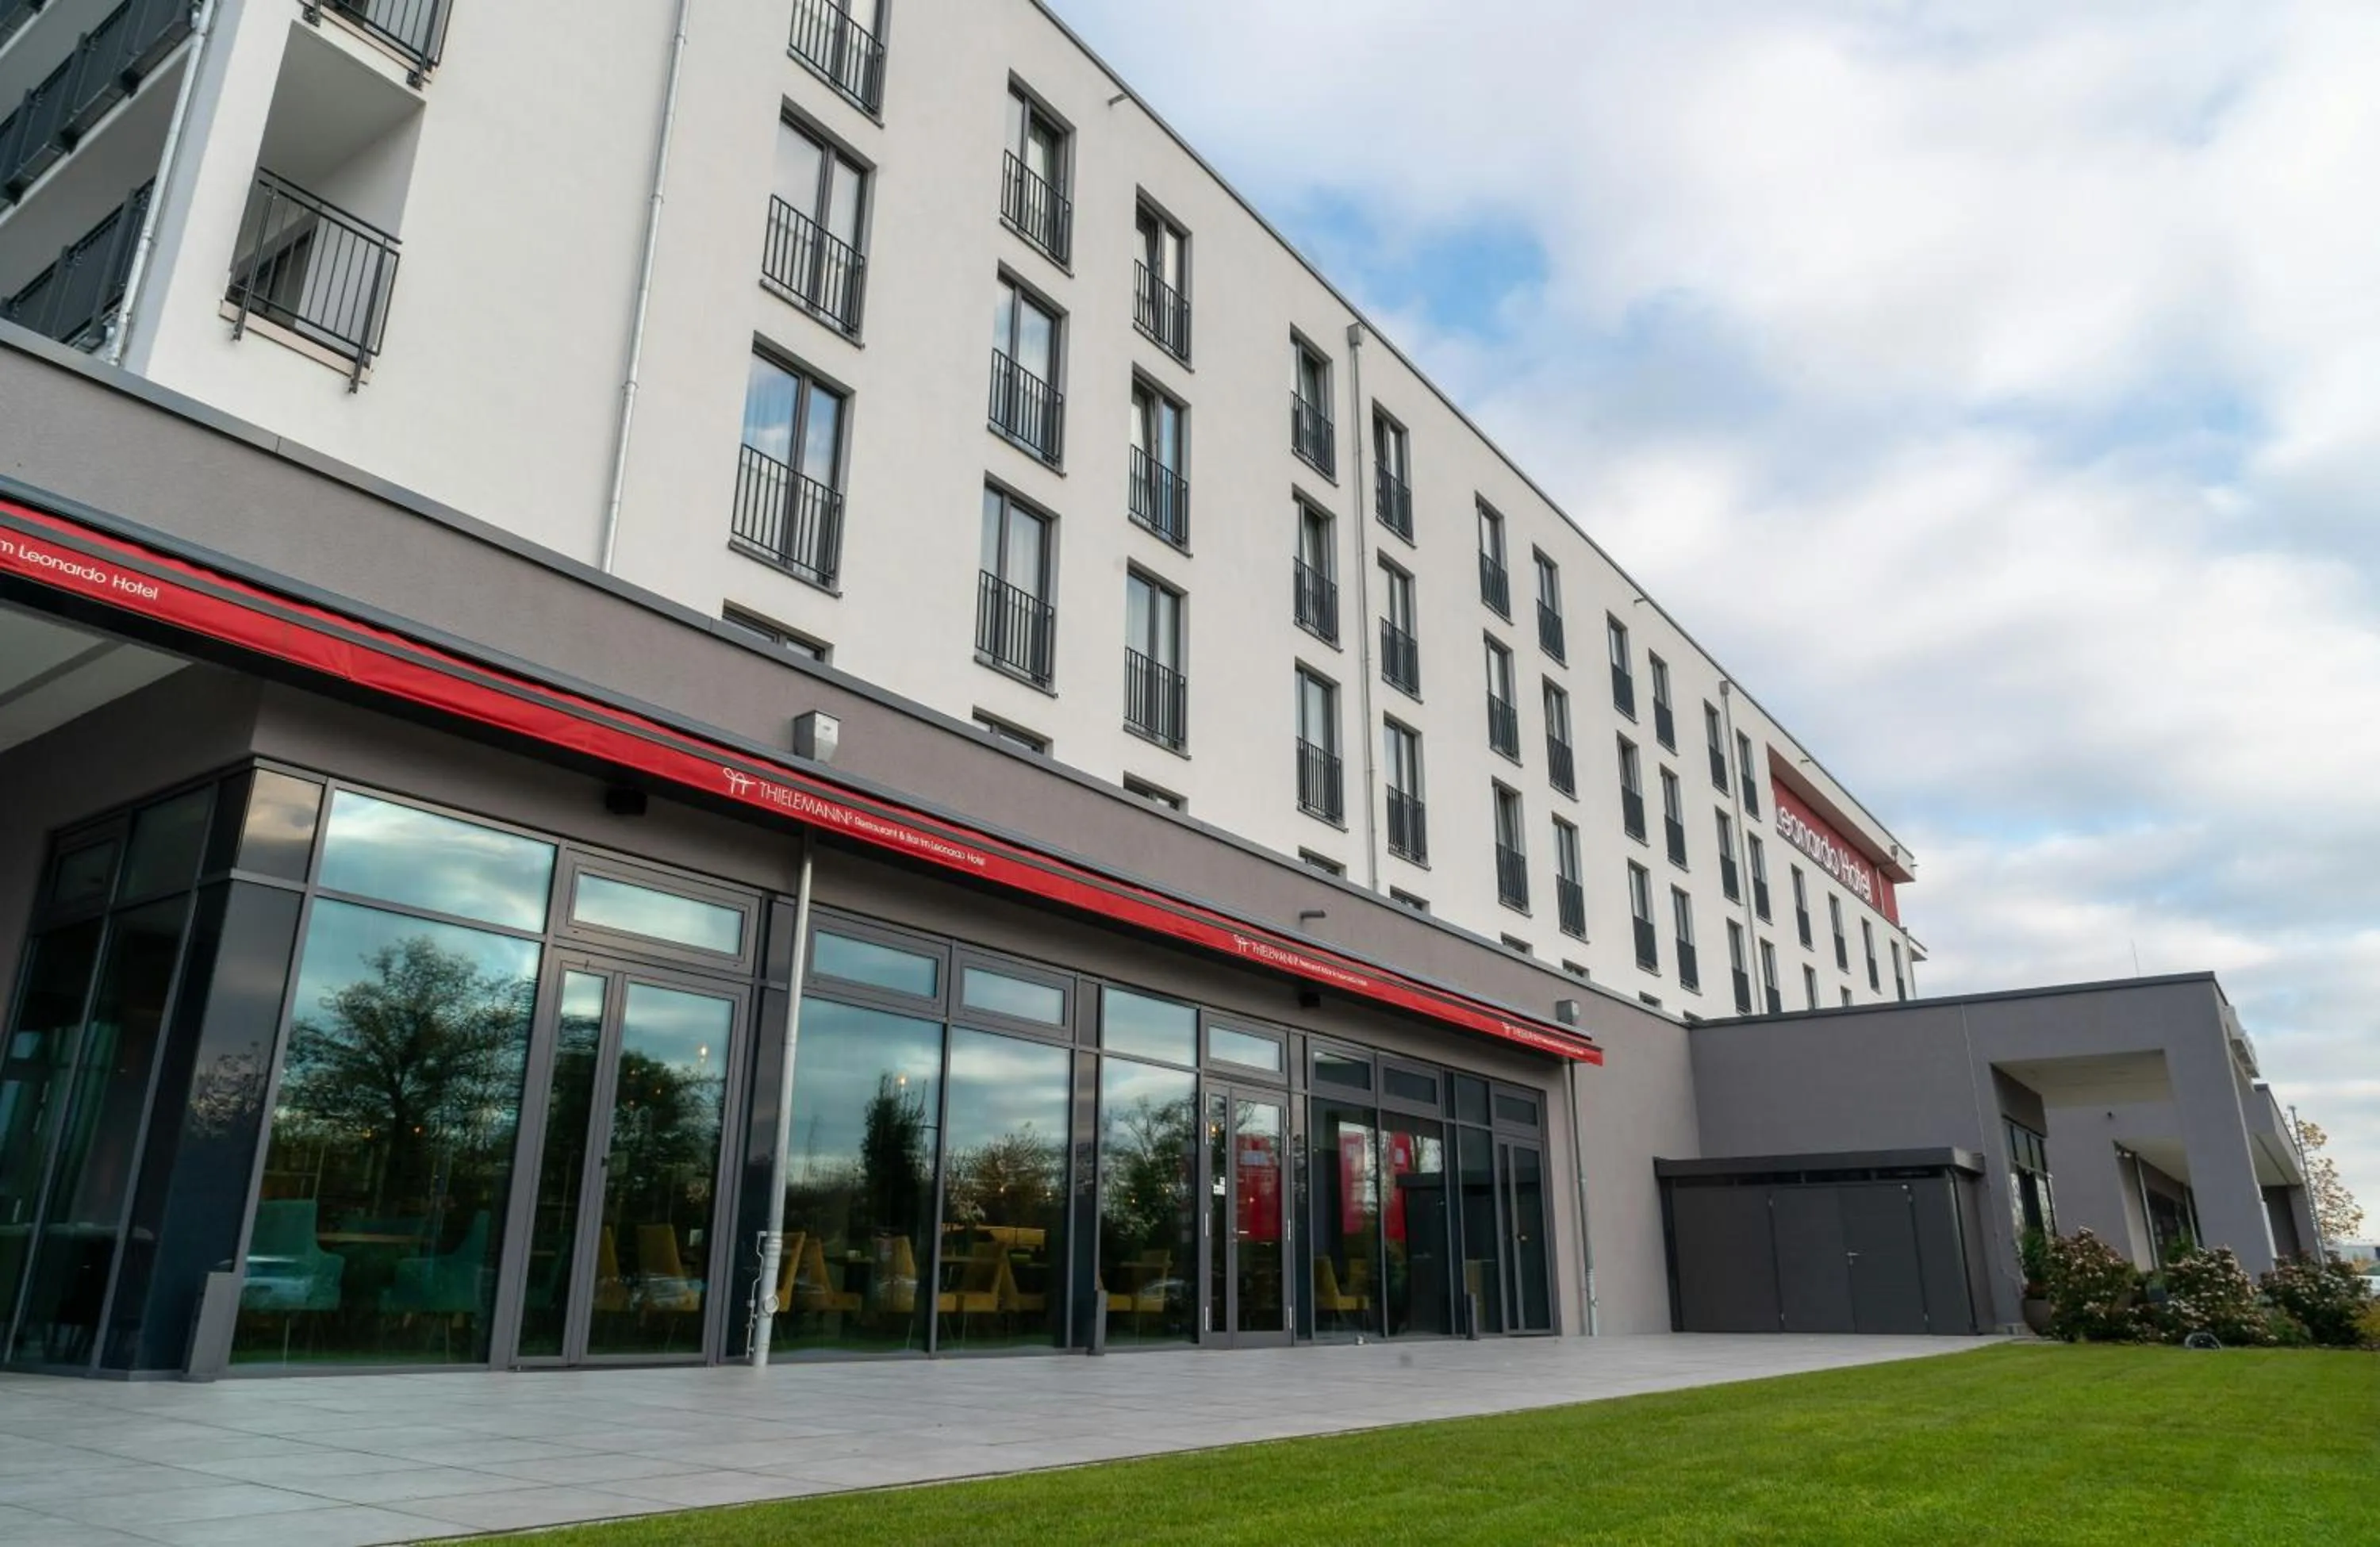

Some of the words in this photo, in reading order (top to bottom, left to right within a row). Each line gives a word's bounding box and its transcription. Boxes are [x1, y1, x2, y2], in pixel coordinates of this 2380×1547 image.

[19, 544, 106, 583] Leonardo
[113, 574, 158, 601] Hotel
[1838, 847, 1873, 903] Hotel
